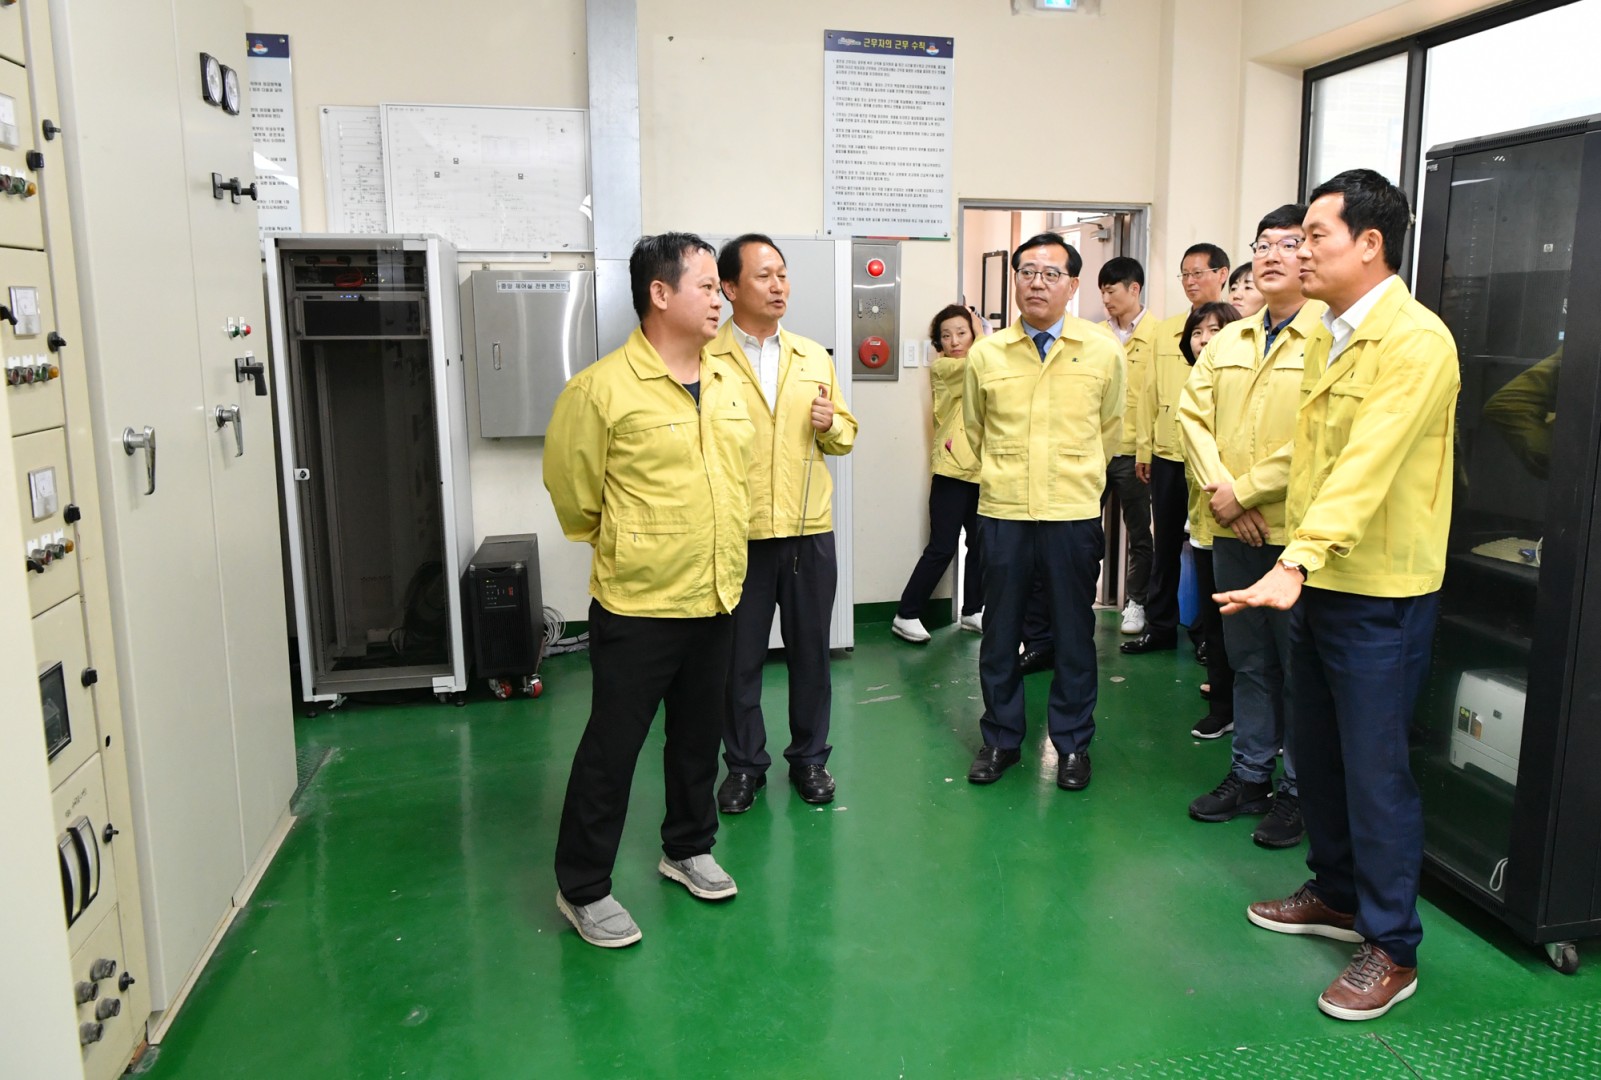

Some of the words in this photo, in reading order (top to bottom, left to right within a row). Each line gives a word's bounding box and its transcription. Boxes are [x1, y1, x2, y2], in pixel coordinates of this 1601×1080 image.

[863, 38, 892, 49] 근무자의
[895, 40, 909, 49] 근무
[912, 41, 926, 51] 수칙
